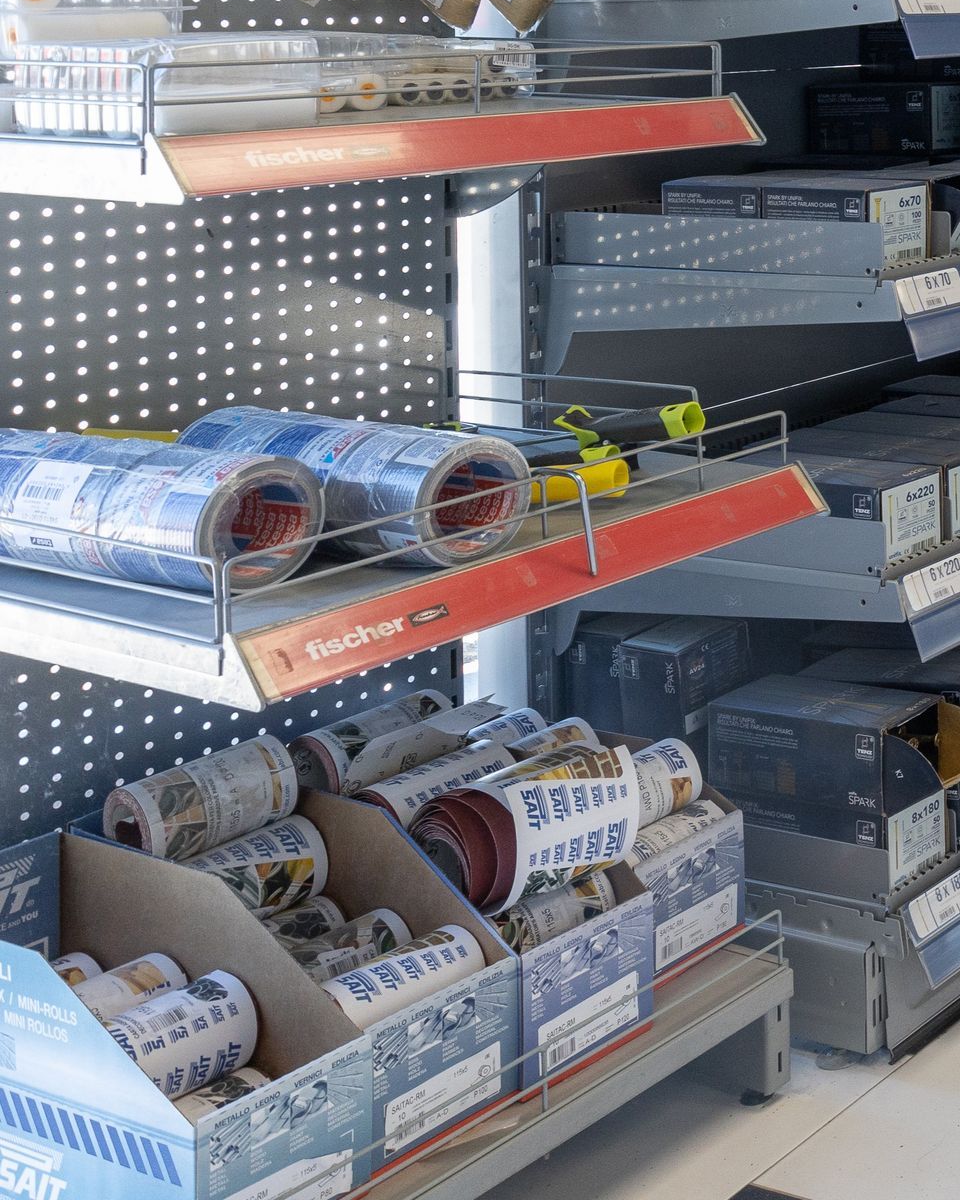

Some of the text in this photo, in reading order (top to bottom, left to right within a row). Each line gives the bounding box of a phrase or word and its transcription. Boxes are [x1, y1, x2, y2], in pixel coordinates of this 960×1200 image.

[245, 147, 345, 168] fischer
[899, 196, 921, 208] 6x70
[906, 485, 934, 502] 6x220
[304, 616, 405, 661] fischer
[911, 800, 940, 824] 8x180
[18, 995, 77, 1026] MINI-ROLLS
[377, 970, 504, 1038] METALLO LEGNO VERNICI EDILIZIA
[4, 1010, 69, 1043] MINI ROLLOS
[214, 1051, 359, 1130] METALLO LEGNO VERNICI EDILIZIA
[0, 1160, 68, 1200] SAIT
